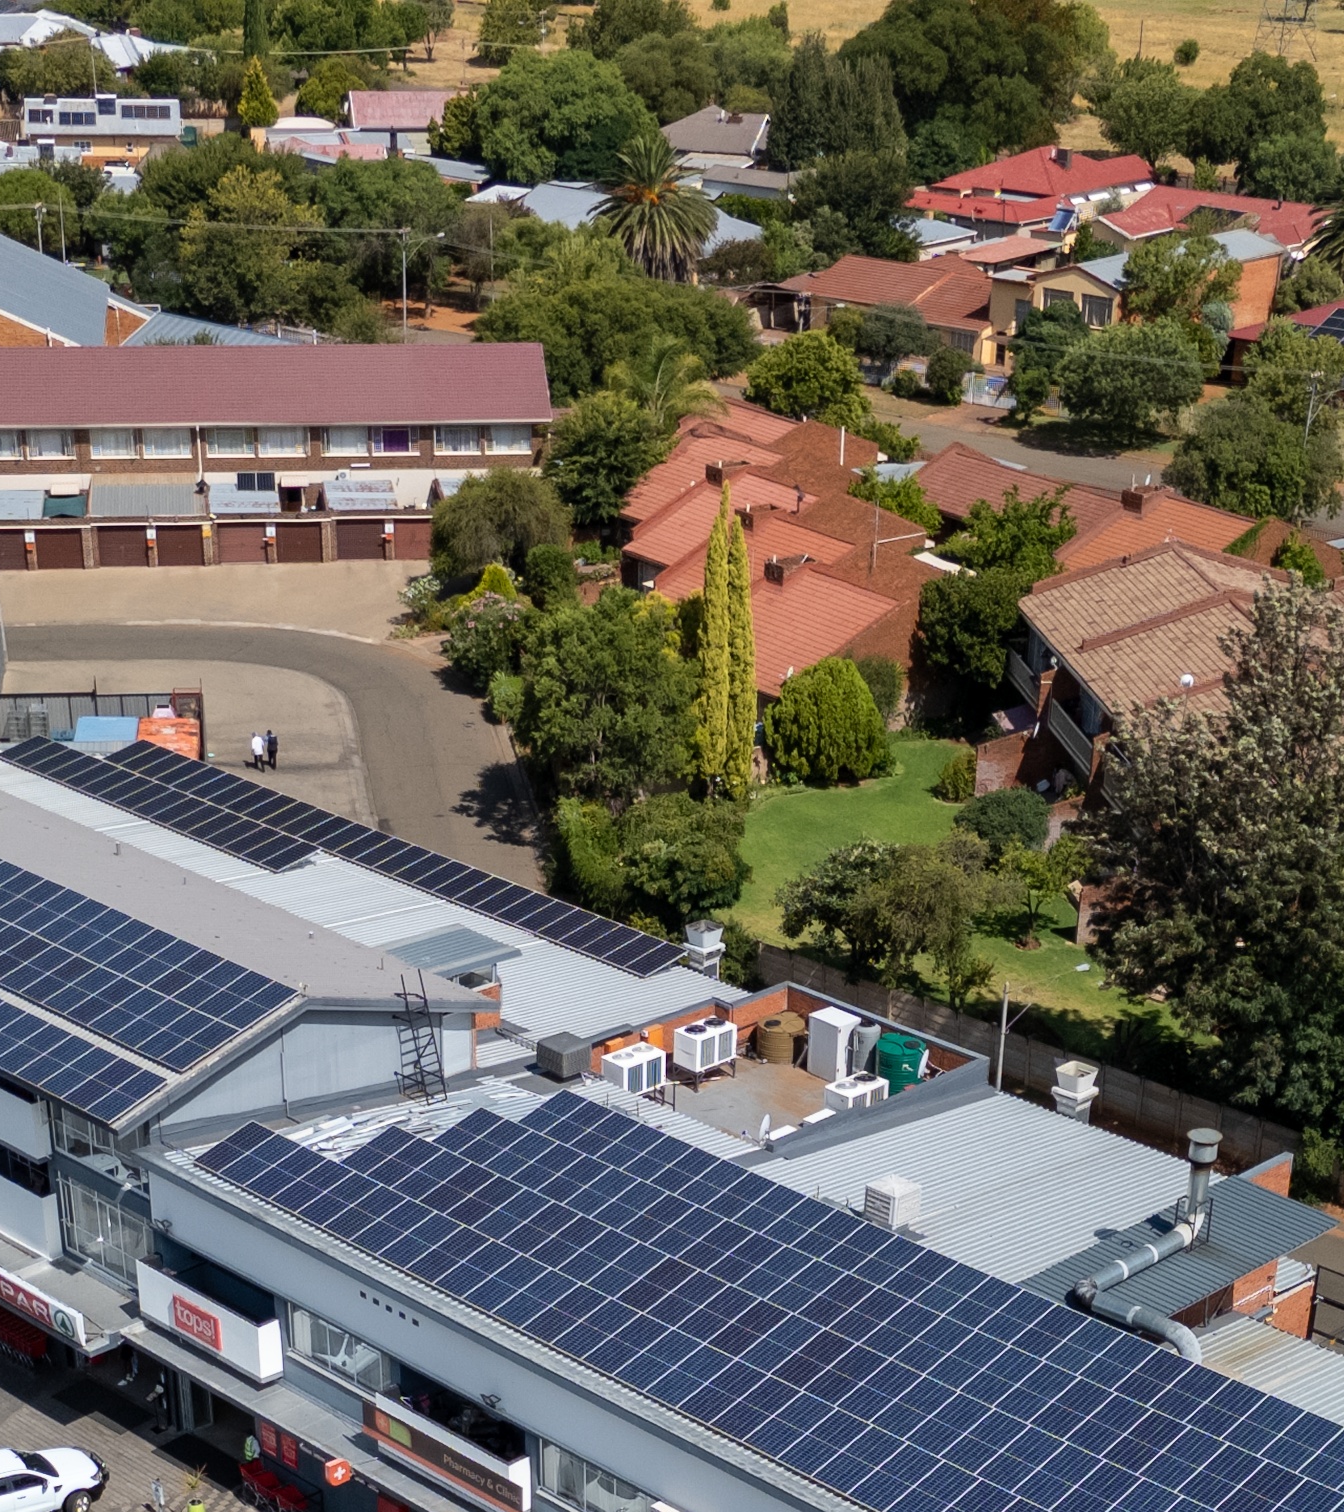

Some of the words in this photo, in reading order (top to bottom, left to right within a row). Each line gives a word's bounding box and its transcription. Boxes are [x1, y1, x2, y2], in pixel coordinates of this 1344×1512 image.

[175, 1300, 216, 1340] tops!
[443, 1453, 485, 1487] Pharmacy
[486, 1478, 494, 1489] &
[495, 1484, 521, 1505] Clinic
